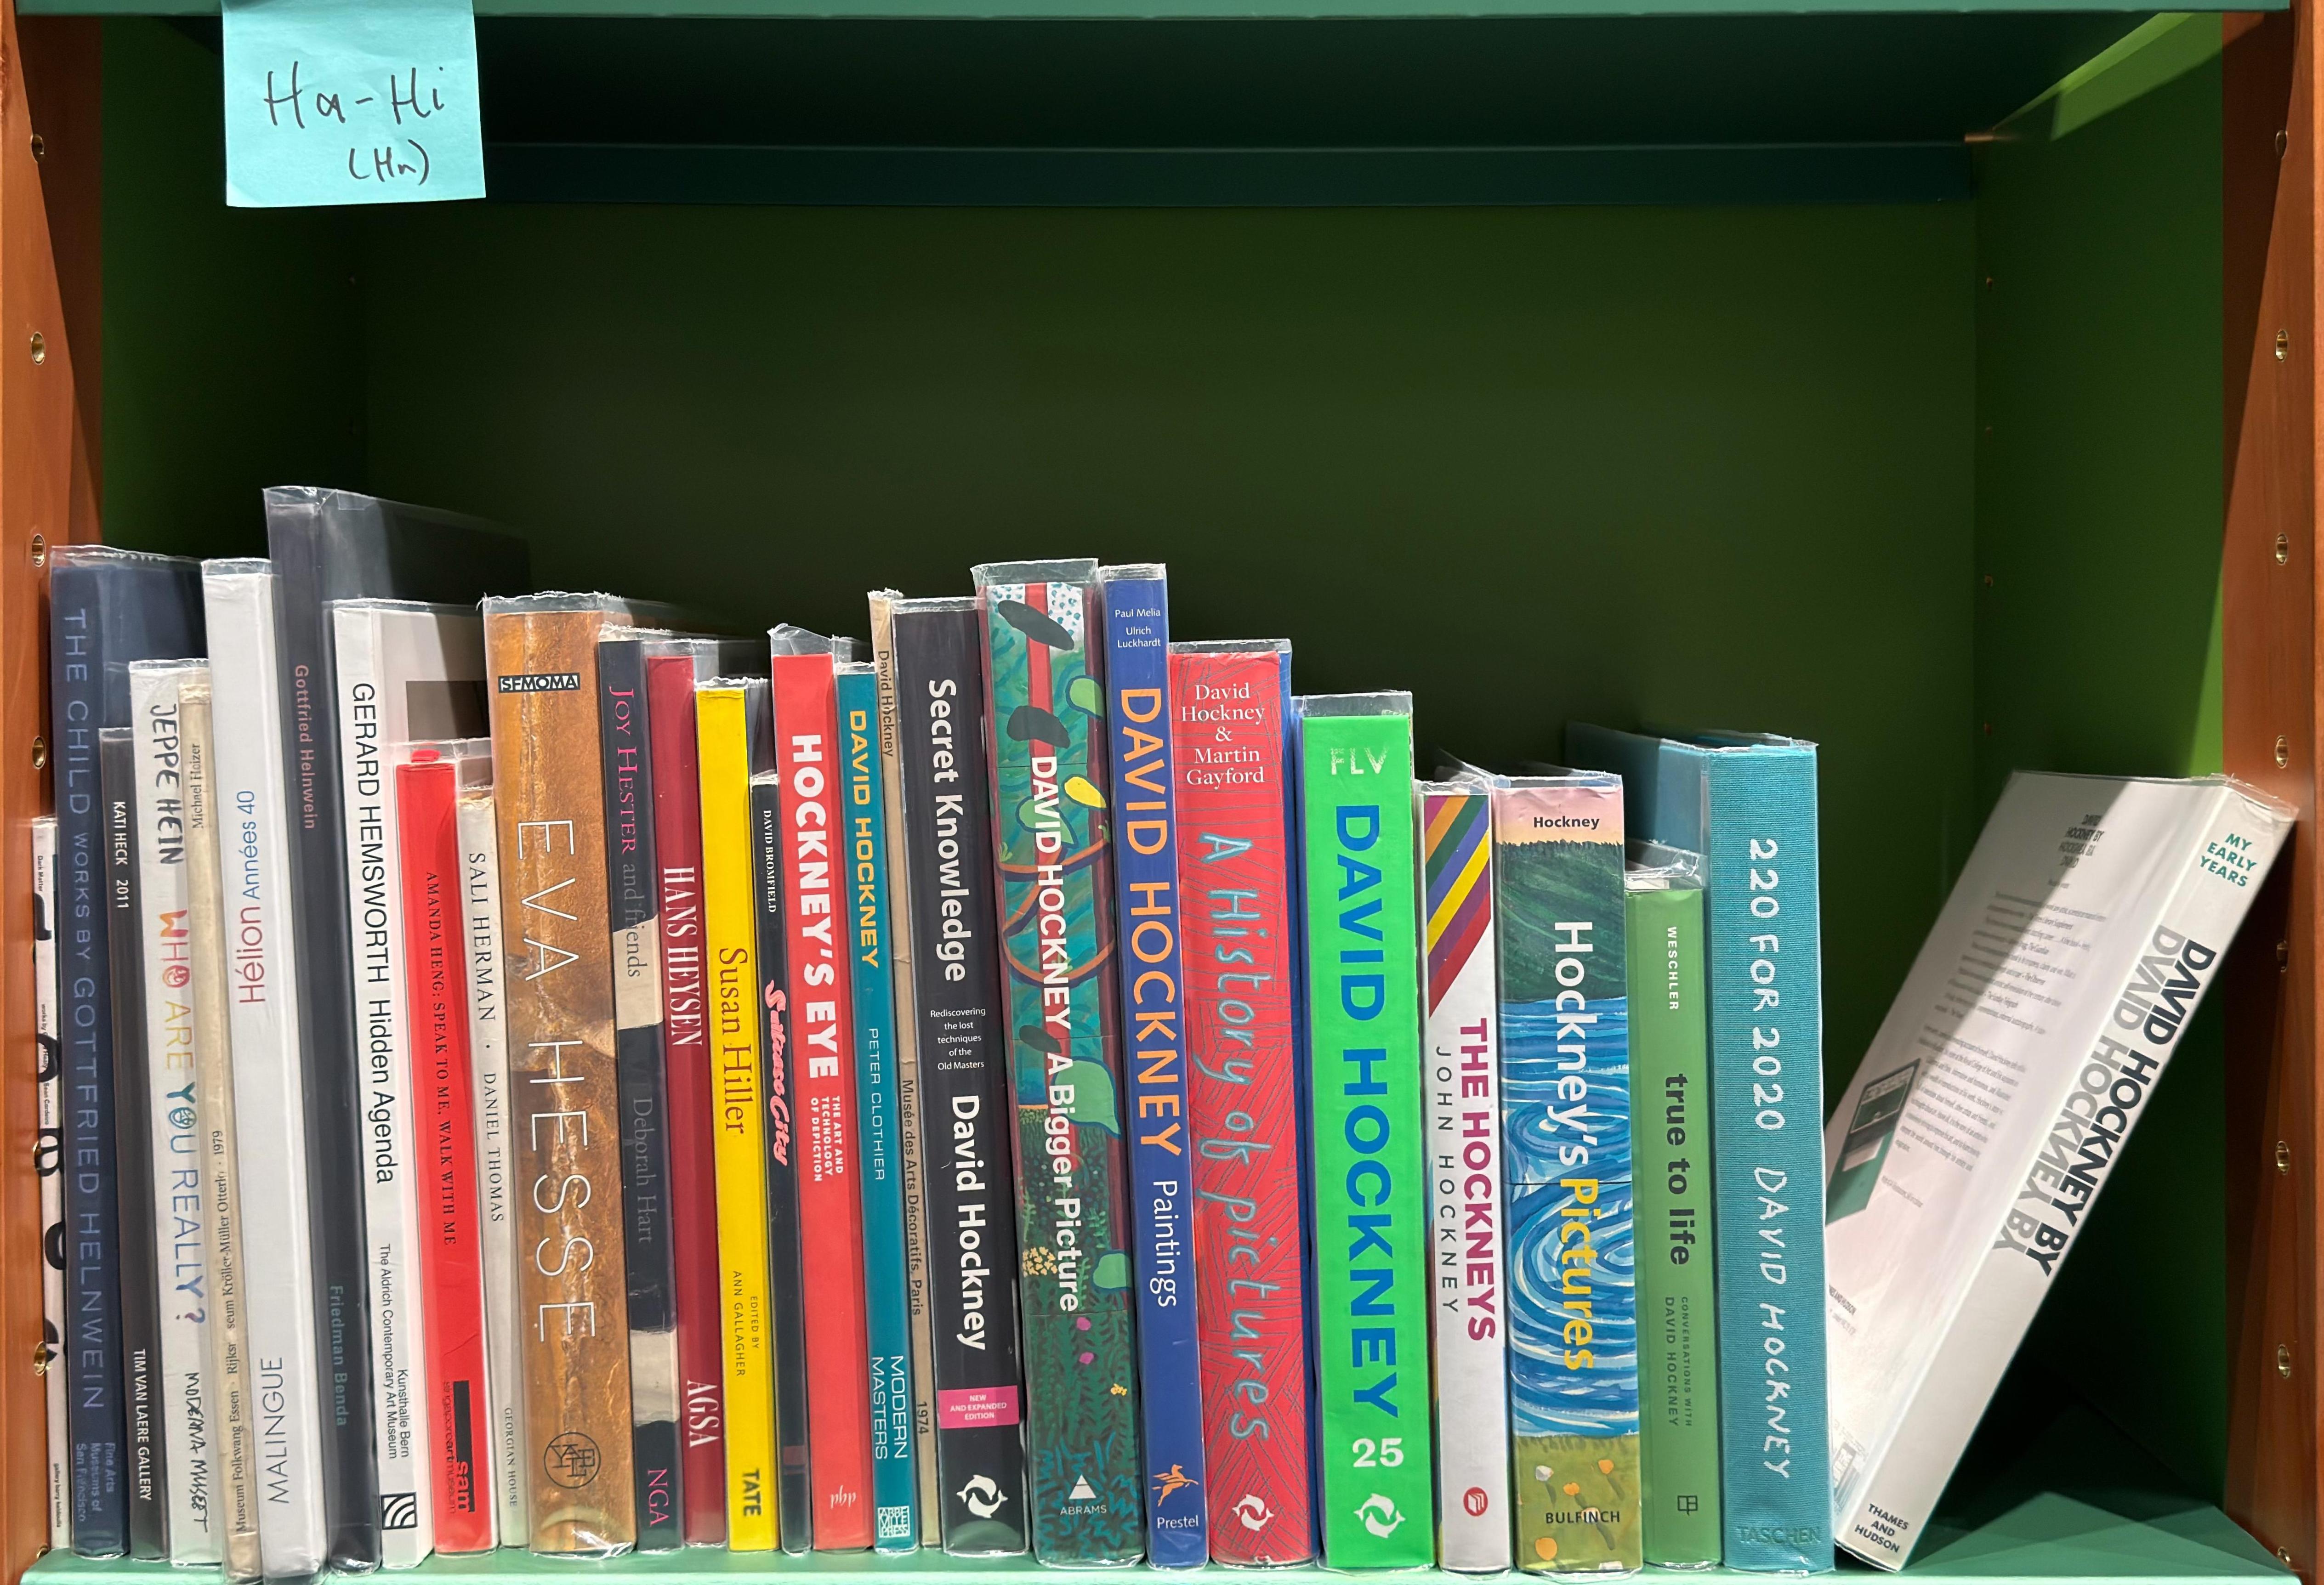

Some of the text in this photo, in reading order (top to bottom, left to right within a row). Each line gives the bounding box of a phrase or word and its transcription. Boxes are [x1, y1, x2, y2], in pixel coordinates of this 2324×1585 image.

[1114, 607, 1161, 618] Paul Melia
[1125, 625, 1151, 635] Ulrich
[1117, 637, 1161, 648] Luckhardt
[499, 674, 580, 692] SFMOMA
[1195, 682, 1251, 701] David
[1181, 704, 1266, 725] Hockney
[1215, 725, 1233, 742] &
[1194, 746, 1260, 764] Martin
[1330, 747, 1387, 776] FLV
[150, 703, 184, 865] JEPPE HEIN
[1186, 766, 1265, 790] Gayford
[190, 785, 204, 829] Michael
[1534, 815, 1600, 830] Hockney
[928, 679, 972, 982] Secret Knowledge
[2225, 833, 2253, 851] MY
[2199, 855, 2248, 887] YEARS
[2207, 841, 2257, 871] EARLY
[234, 790, 266, 1004] Hélion Années 40
[623, 864, 645, 900] and
[426, 872, 442, 942] AMANDA
[159, 909, 190, 988] WHO
[352, 683, 398, 1184] GERARD HEMSWORTH Hidden Agenda
[624, 909, 648, 978] friends
[430, 946, 445, 997] HENG:
[1667, 927, 1679, 1010] WESCHLER
[65, 608, 105, 1409] THE CHILD WORKS BY GOTTFRIED HELNWEIN
[432, 1002, 447, 1053] SPEAK
[930, 1008, 986, 1018] Rediscovering
[944, 1022, 957, 1030] the
[164, 1000, 194, 1070] ARE
[468, 853, 504, 1222] SALI HERMAN DANIEL THOMAS
[937, 1035, 982, 1044] techniques
[949, 1047, 972, 1056] of the
[1031, 755, 1082, 1312] DAVID HOCKNEY A Bigger Picture
[436, 1059, 449, 1080] TO
[937, 1062, 952, 1070] Old
[166, 1081, 197, 1154] YOU
[902, 1080, 916, 1127] Musée
[439, 1121, 453, 1166] WALK
[810, 1097, 823, 1182] OF DEPICTION
[821, 1096, 833, 1176] TECHNOLOGY
[905, 1131, 917, 1155] des
[1192, 832, 1281, 1441] A History of pictures
[1749, 838, 1791, 1478] 220 FOR 2020 DAVID HOCKNEY
[633, 1097, 658, 1244] Deborah Hart
[906, 1159, 919, 1190] Arts
[1435, 1046, 1458, 1313] JOHN HOCKNEY
[1665, 1073, 1696, 1265] true to life
[441, 1171, 455, 1215] WITH
[443, 1222, 456, 1245] ME
[1560, 1178, 1601, 1370] Pictures
[910, 1279, 924, 1316] Paris
[212, 1130, 247, 1532] Museum Folkwang Essen Kröller-Müller 1979
[733, 1270, 746, 1377] ANN GALLAGHER
[750, 1296, 760, 1349] EDITED BY
[379, 1244, 398, 1459] The Aldrich Contemporary Art Museum
[1681, 1296, 1693, 1427] CONVERSATIONS WITH
[134, 1348, 152, 1500] TIM VAN LAERE GALLERY
[397, 1369, 411, 1457] Kunsthalle Bern
[687, 1379, 720, 1448] AGSA
[872, 1357, 888, 1460] MASTERS
[890, 1355, 908, 1459] MODERN
[917, 1401, 929, 1435] 1974
[964, 1412, 995, 1421] EDITION
[967, 1402, 1007, 1411] EXPANDED
[260, 1357, 290, 1504] MALINGUE
[75, 1443, 86, 1464] San
[104, 1442, 116, 1492] Fine Arts
[504, 1408, 518, 1507] GEORGIAN HOUSE
[1352, 1438, 1405, 1468] 25
[91, 1443, 102, 1511] Museums of
[1060, 1504, 1107, 1515] ABRAMS
[1157, 1515, 1199, 1529] Prestel
[1546, 1511, 1620, 1523] BULFINCH
[1868, 1503, 1909, 1531] THAMES
[1870, 1520, 1895, 1538] AND
[1737, 1526, 1821, 1545] TASCHEN
[1854, 1524, 1900, 1554] HUDSON
